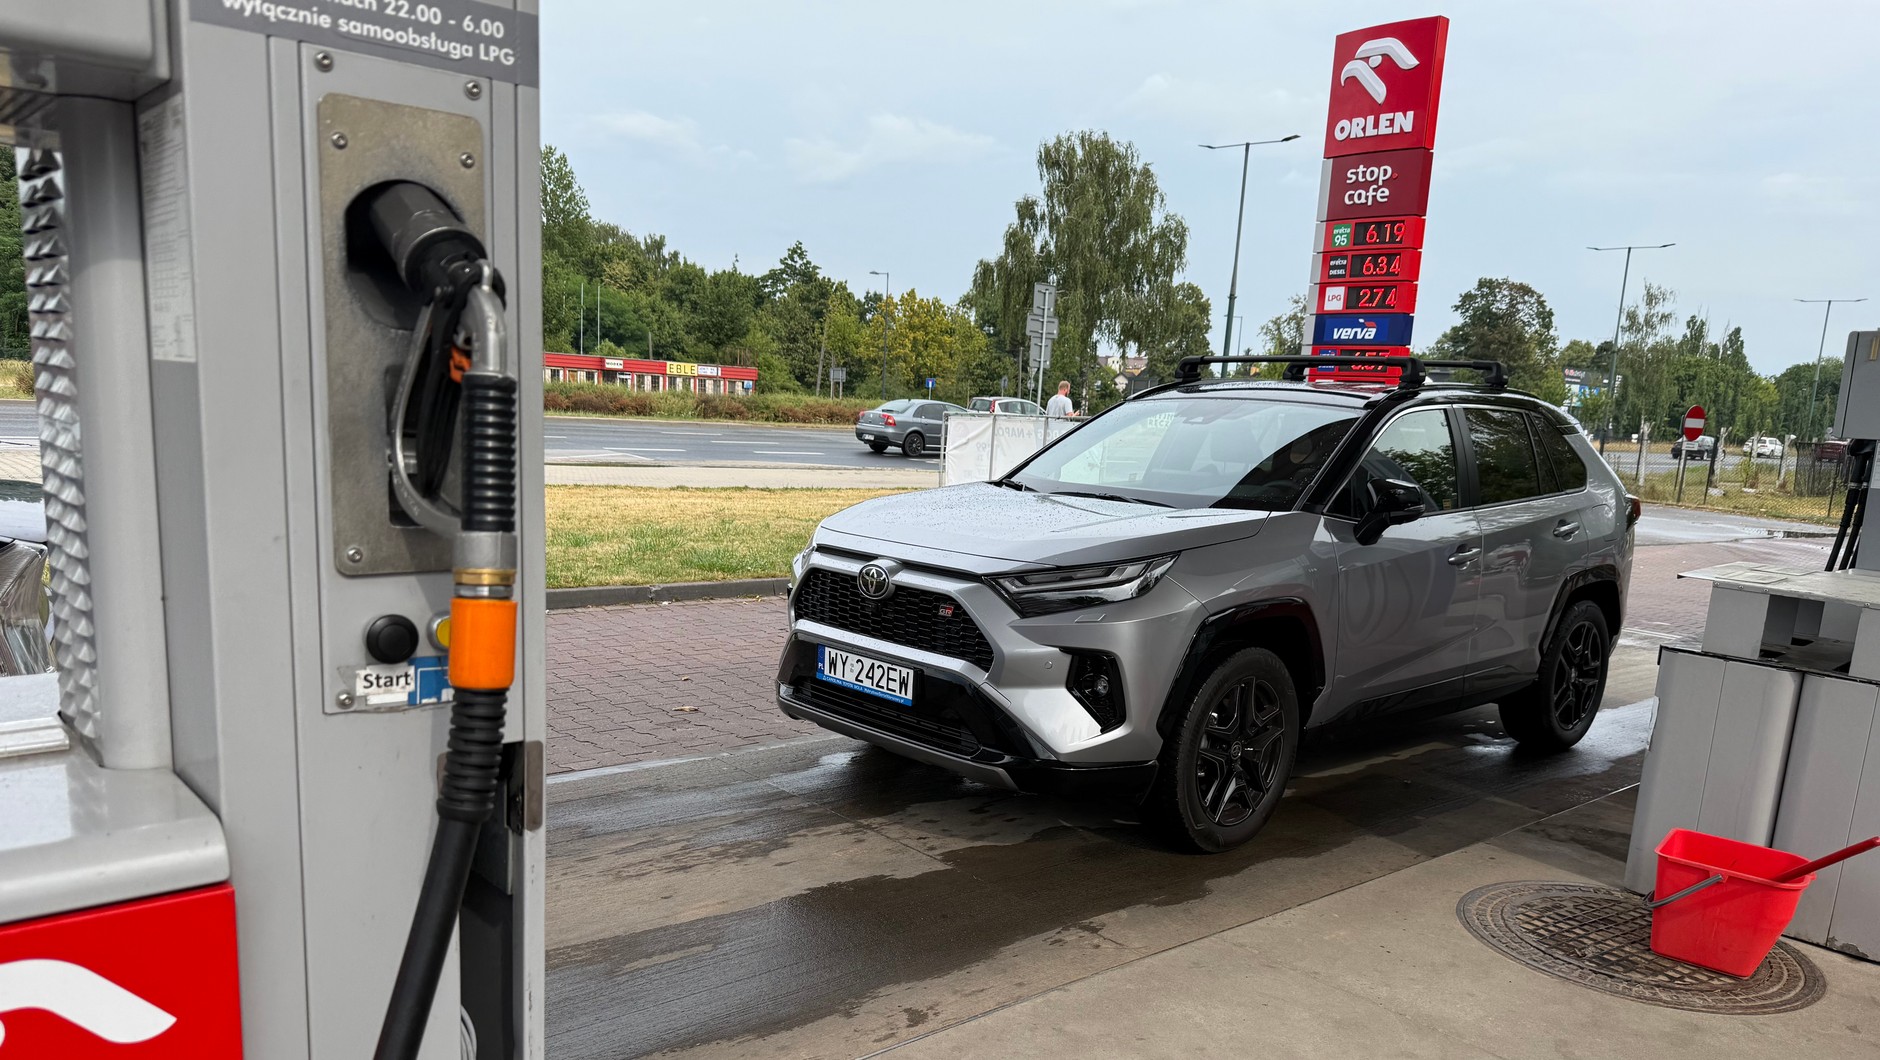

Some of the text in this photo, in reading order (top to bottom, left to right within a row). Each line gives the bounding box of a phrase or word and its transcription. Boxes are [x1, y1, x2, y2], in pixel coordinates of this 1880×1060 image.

[384, 0, 442, 25] 22.00
[462, 15, 504, 38] 6.00
[337, 18, 473, 59] samoobsługa
[479, 43, 515, 65] LPG
[1334, 111, 1414, 141] ORLEN
[1344, 184, 1390, 206] cafe
[1334, 234, 1348, 247] 95
[1366, 222, 1405, 243] 6.19
[1362, 255, 1401, 276] 6.34
[1327, 294, 1342, 302] LPG
[1358, 287, 1397, 308] 2.74
[1332, 327, 1377, 340] verva
[668, 363, 696, 375] EBLE
[818, 662, 824, 670] PL
[828, 650, 849, 679] WY
[854, 658, 910, 697] 242EW
[363, 671, 411, 689] Start
